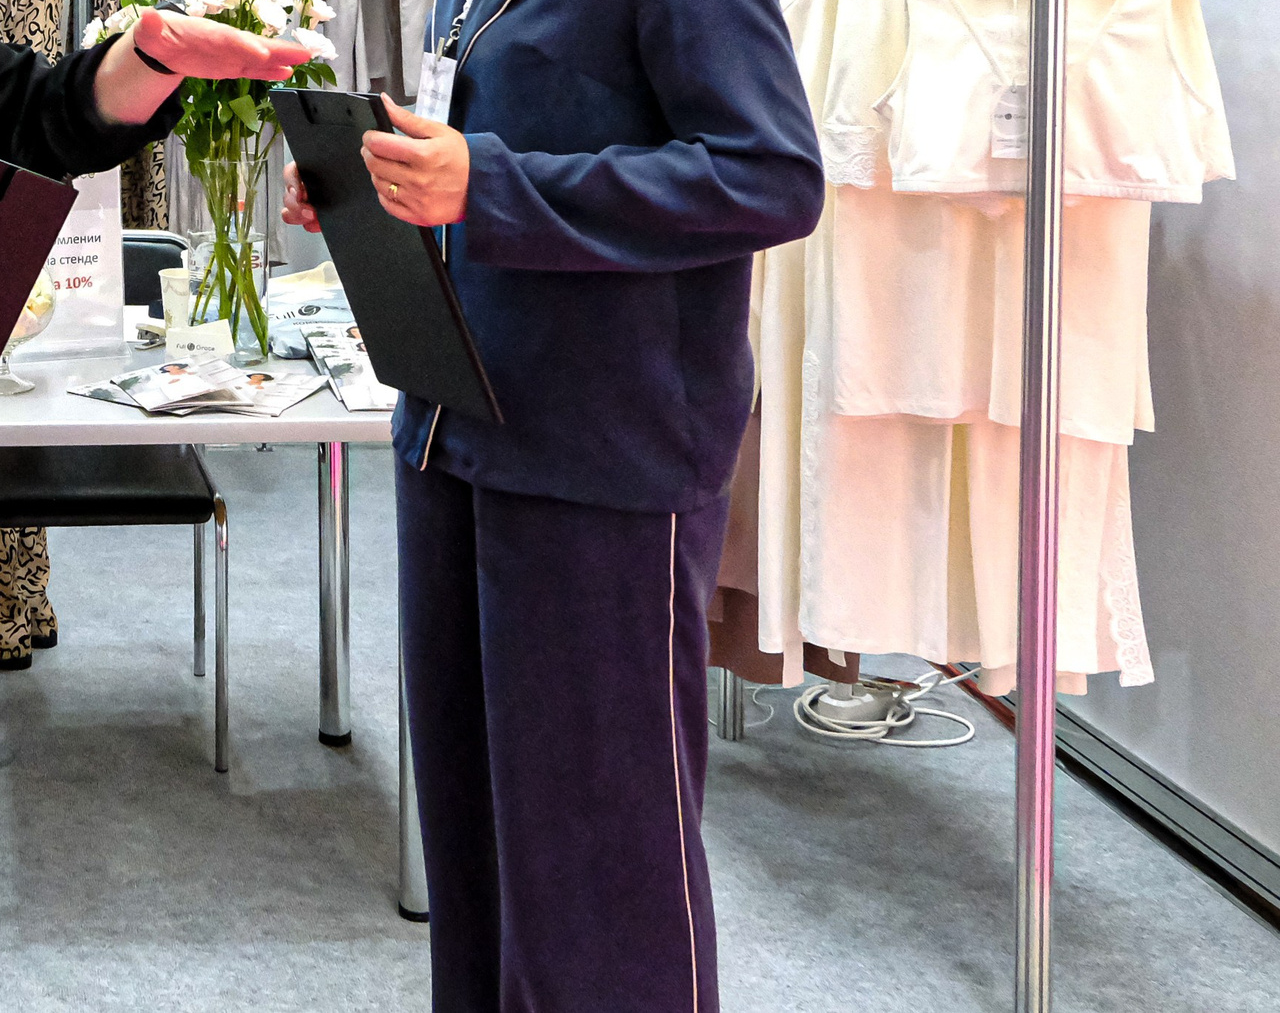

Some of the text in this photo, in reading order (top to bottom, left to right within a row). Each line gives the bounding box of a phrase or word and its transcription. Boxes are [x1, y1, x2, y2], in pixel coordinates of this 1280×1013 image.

[54, 235, 101, 245] млении
[59, 254, 99, 266] стенде
[65, 276, 93, 290] 10%
